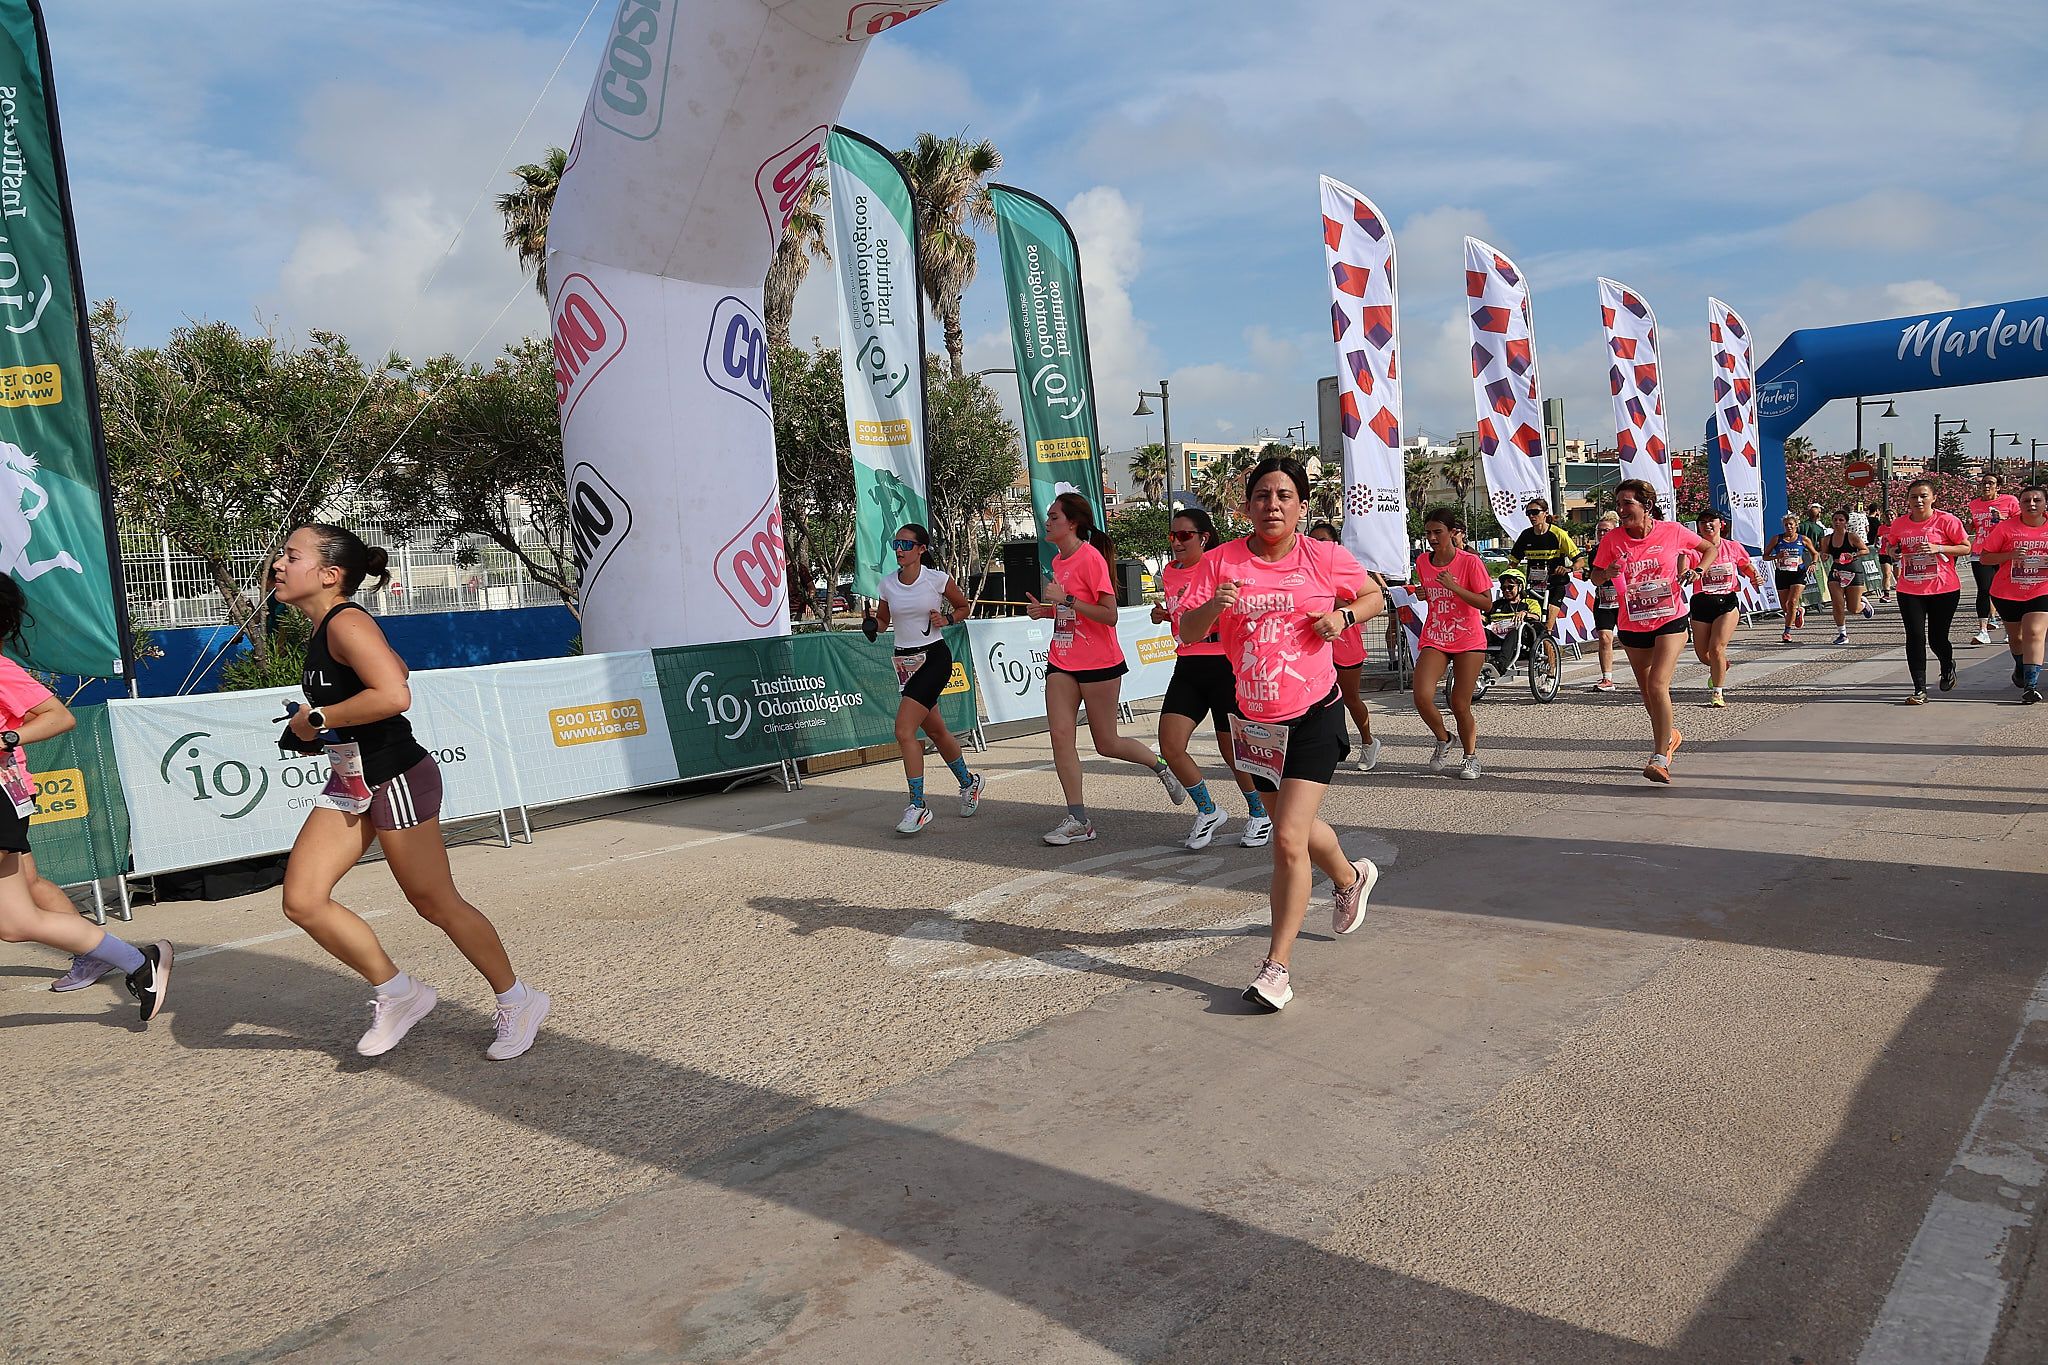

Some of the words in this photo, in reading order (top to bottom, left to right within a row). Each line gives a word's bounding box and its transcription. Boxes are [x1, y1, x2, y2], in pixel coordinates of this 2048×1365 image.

[1898, 309, 2048, 376] Marlen
[1642, 597, 1659, 605] 016
[1259, 618, 1282, 644] DE
[751, 674, 826, 697] Institutos
[758, 690, 863, 718] Odontológicos
[556, 713, 585, 727] 900
[588, 709, 608, 723] 131
[611, 705, 638, 719] 002
[794, 717, 828, 729] dentales
[559, 721, 640, 741] www.ioa.es
[1250, 745, 1274, 758] 016
